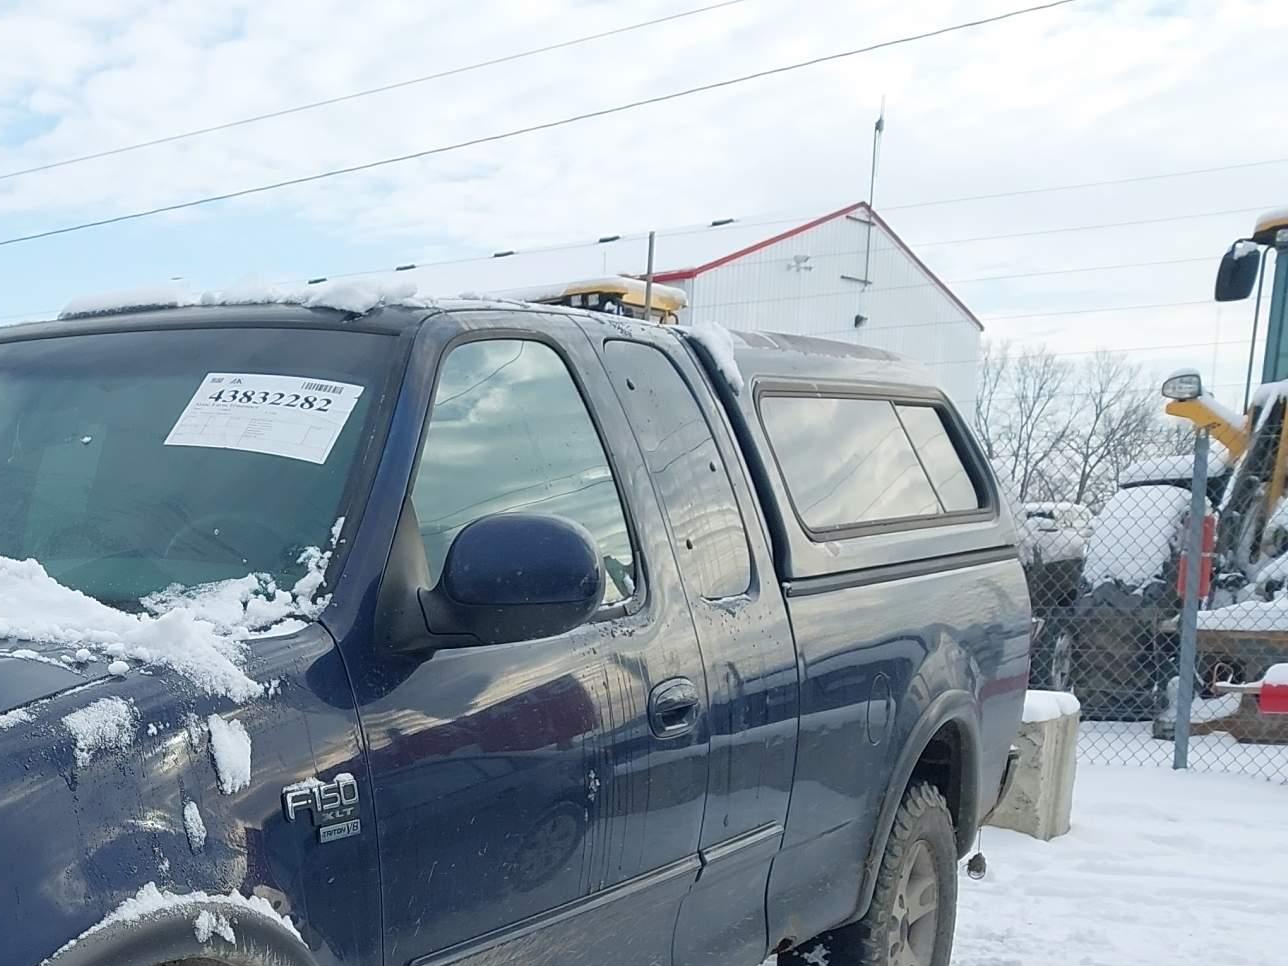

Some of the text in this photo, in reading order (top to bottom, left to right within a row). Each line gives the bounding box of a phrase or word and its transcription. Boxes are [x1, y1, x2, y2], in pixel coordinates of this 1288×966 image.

[209, 389, 333, 413] 43832282
[322, 806, 355, 821] XLT
[322, 821, 359, 838] TRITON V8
